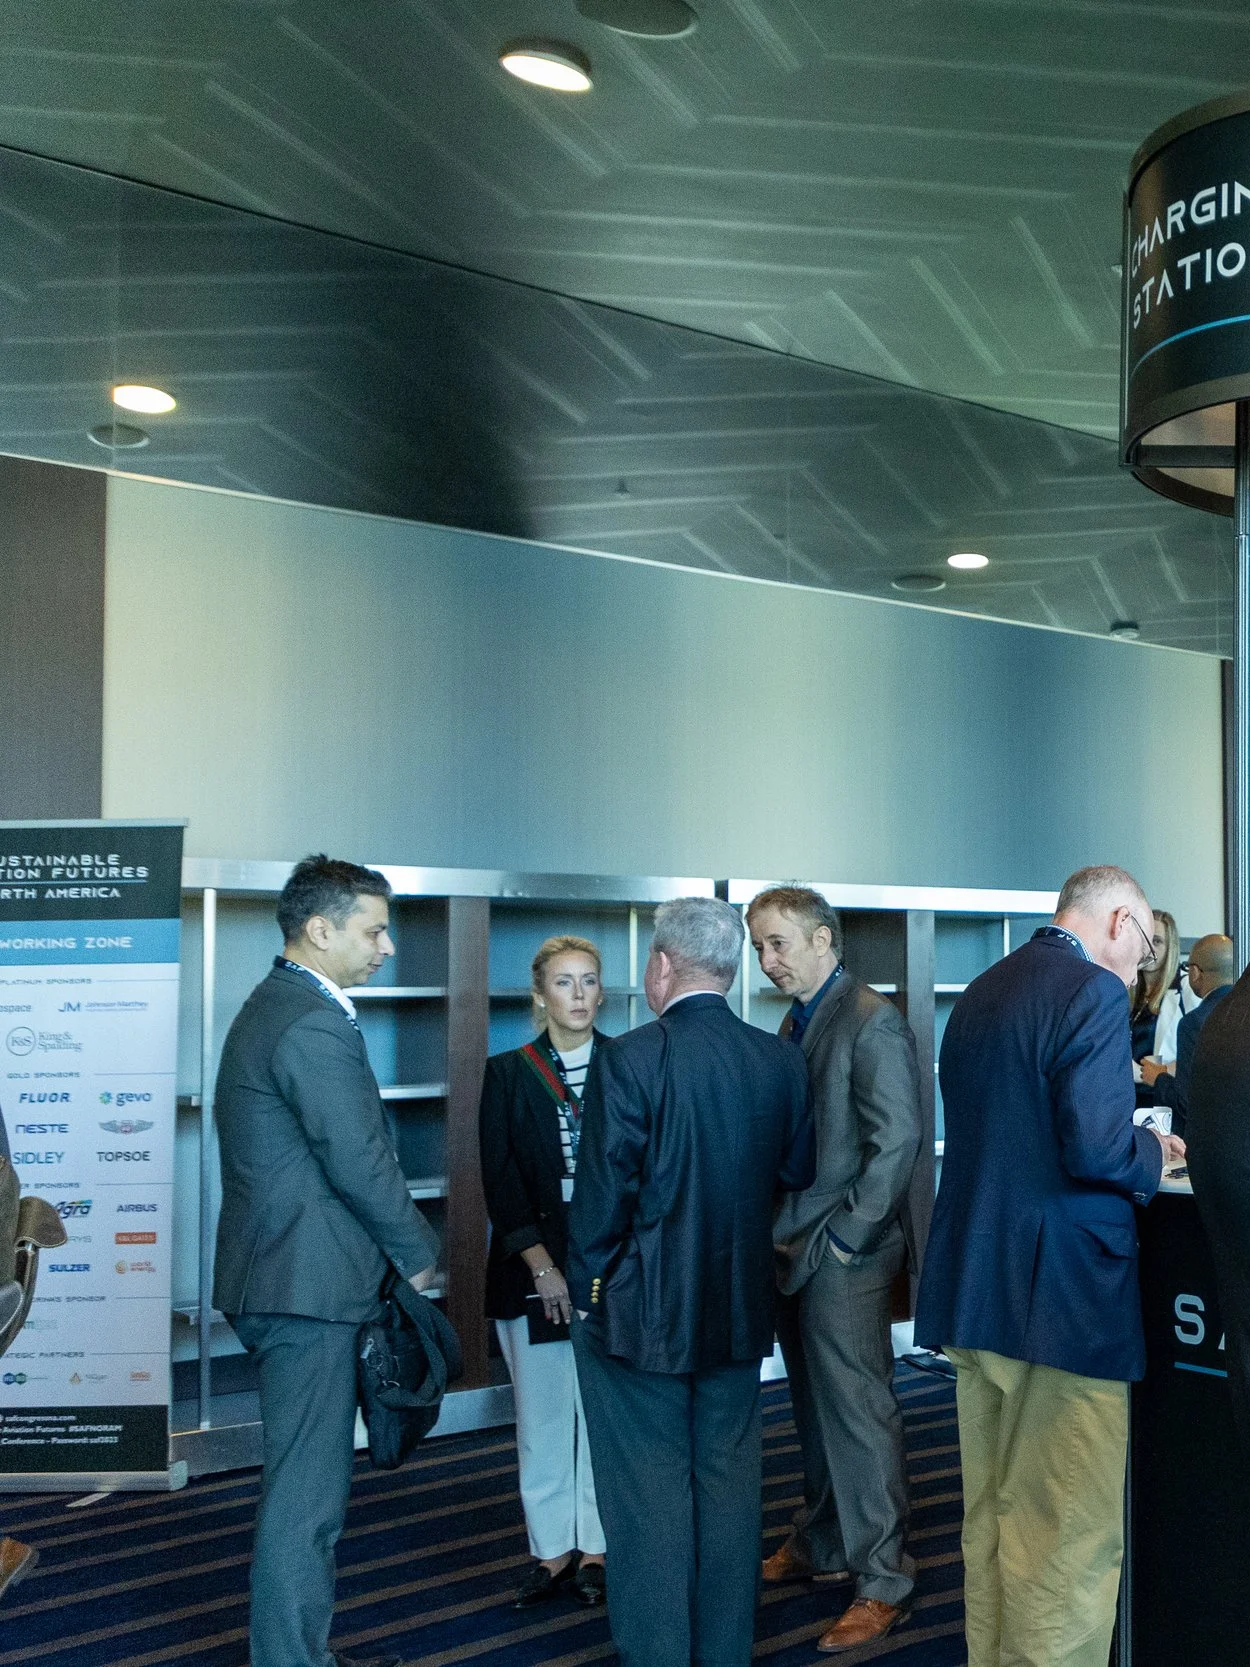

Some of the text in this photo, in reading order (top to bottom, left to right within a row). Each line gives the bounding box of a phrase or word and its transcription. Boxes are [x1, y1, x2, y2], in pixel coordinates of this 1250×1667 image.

[51, 866, 150, 878] FUTURES
[0, 887, 122, 899] RTH AMERICA
[84, 936, 135, 948] ZONE
[58, 1001, 81, 1013] JM
[18, 1092, 152, 1107] FLUOR gevo
[13, 1151, 151, 1164] SIDLEY TOPSOE
[116, 1203, 158, 1213] AIRBUS
[48, 1264, 91, 1272] SULZER
